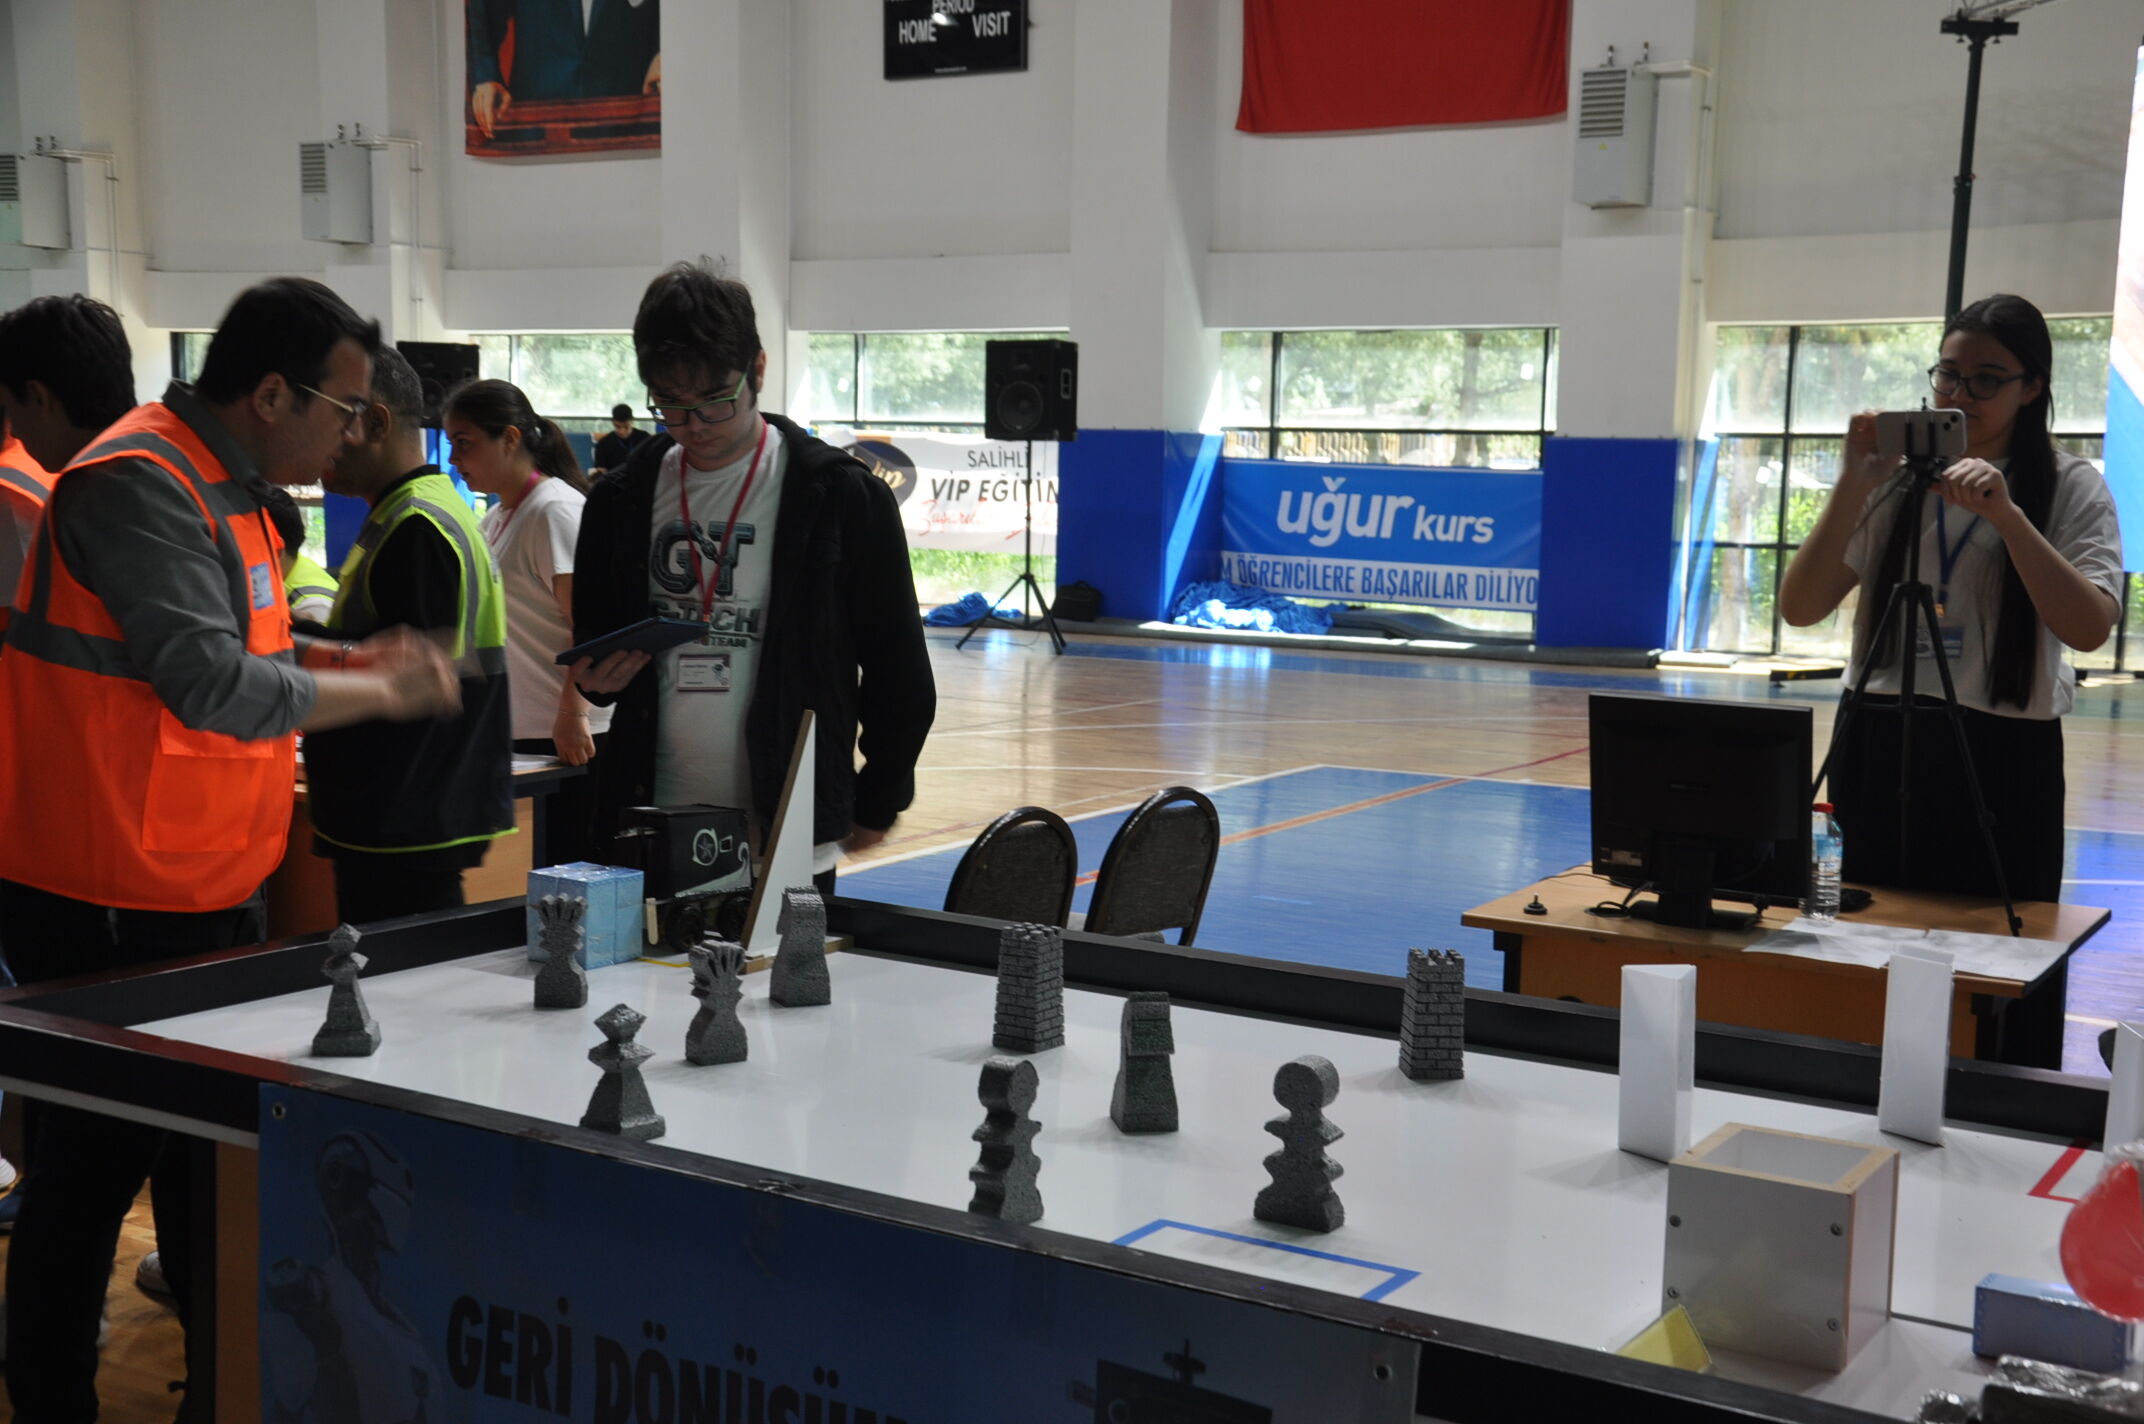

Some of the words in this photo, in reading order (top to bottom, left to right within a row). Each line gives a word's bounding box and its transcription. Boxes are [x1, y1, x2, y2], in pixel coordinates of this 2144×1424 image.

[898, 19, 938, 44] HOME
[972, 11, 1012, 38] VISIT
[1276, 476, 1416, 547] uğur
[1413, 505, 1495, 544] kurs
[1237, 554, 1356, 594] ÖĞRENCİLERE
[1361, 567, 1468, 600] BAŞARILAR
[1475, 569, 1537, 604] DİLİYO
[447, 1295, 573, 1418] GERİ
